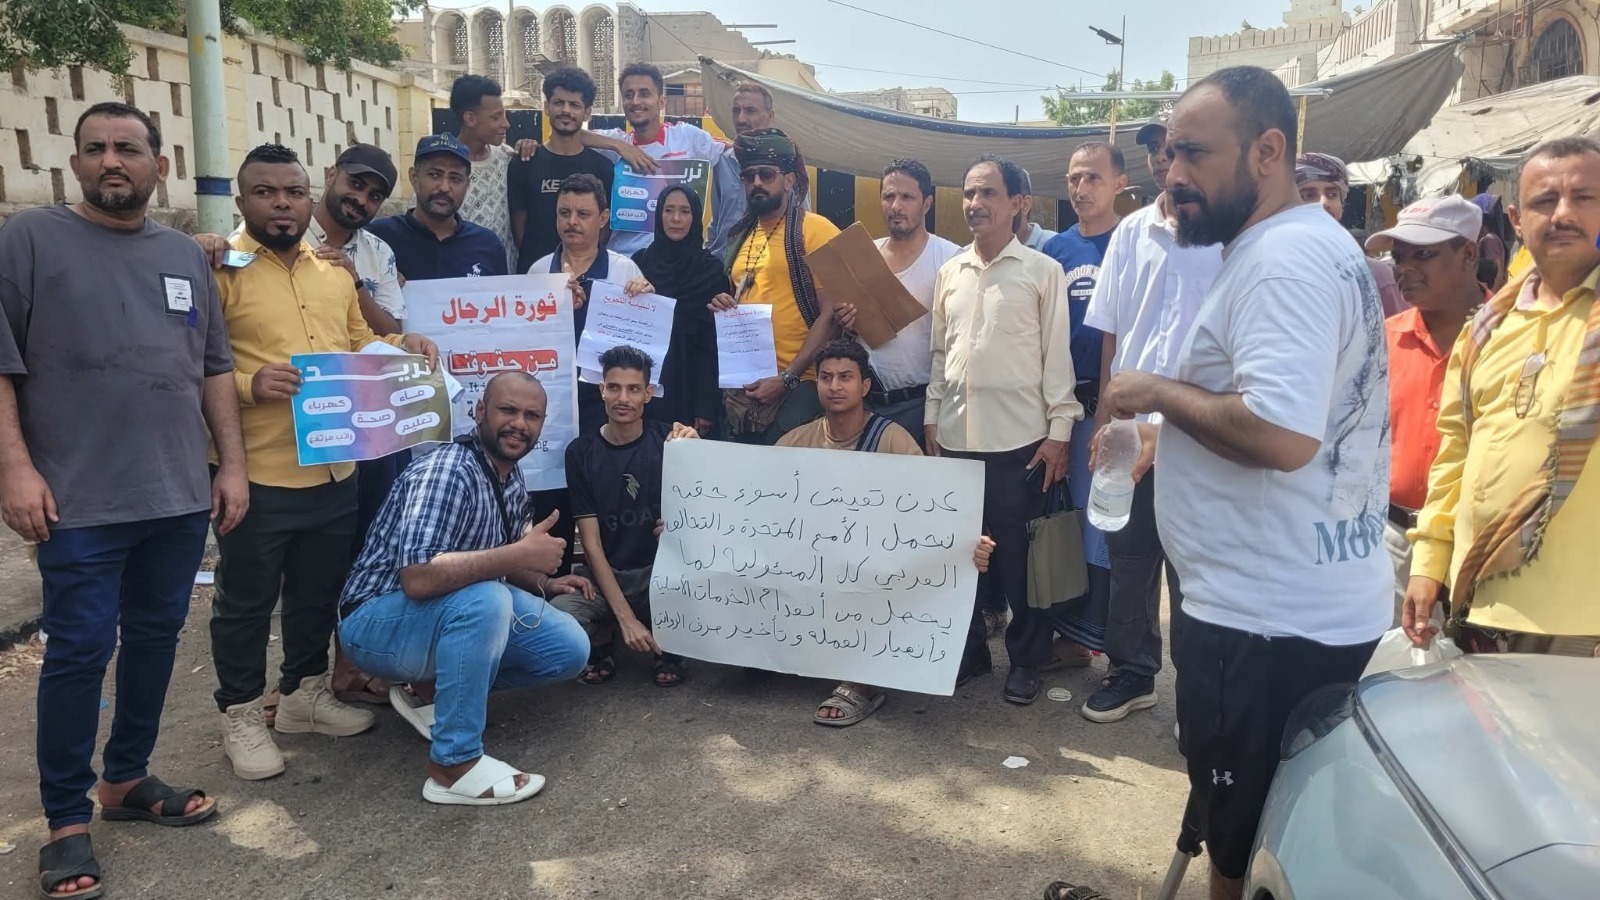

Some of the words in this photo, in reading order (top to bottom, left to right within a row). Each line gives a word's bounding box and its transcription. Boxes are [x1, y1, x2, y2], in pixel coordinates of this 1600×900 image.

[441, 294, 507, 324] الرجال
[515, 293, 557, 322] ثورة
[304, 359, 432, 382] نريد
[450, 349, 521, 379] حقوقنا
[527, 351, 557, 376] من
[399, 389, 424, 402] ماء
[469, 382, 479, 392] It
[308, 401, 346, 411] كهرباء
[357, 413, 391, 423] صحة
[335, 431, 352, 441] راتب
[402, 416, 433, 433] تعليم
[309, 434, 333, 444] مرتفع
[809, 486, 885, 512] تعيش
[882, 523, 955, 551] نحمل
[679, 539, 716, 571] لما
[836, 555, 870, 584] كل
[874, 563, 957, 591] العربي
[834, 610, 862, 623] من
[870, 600, 952, 635] يحصل
